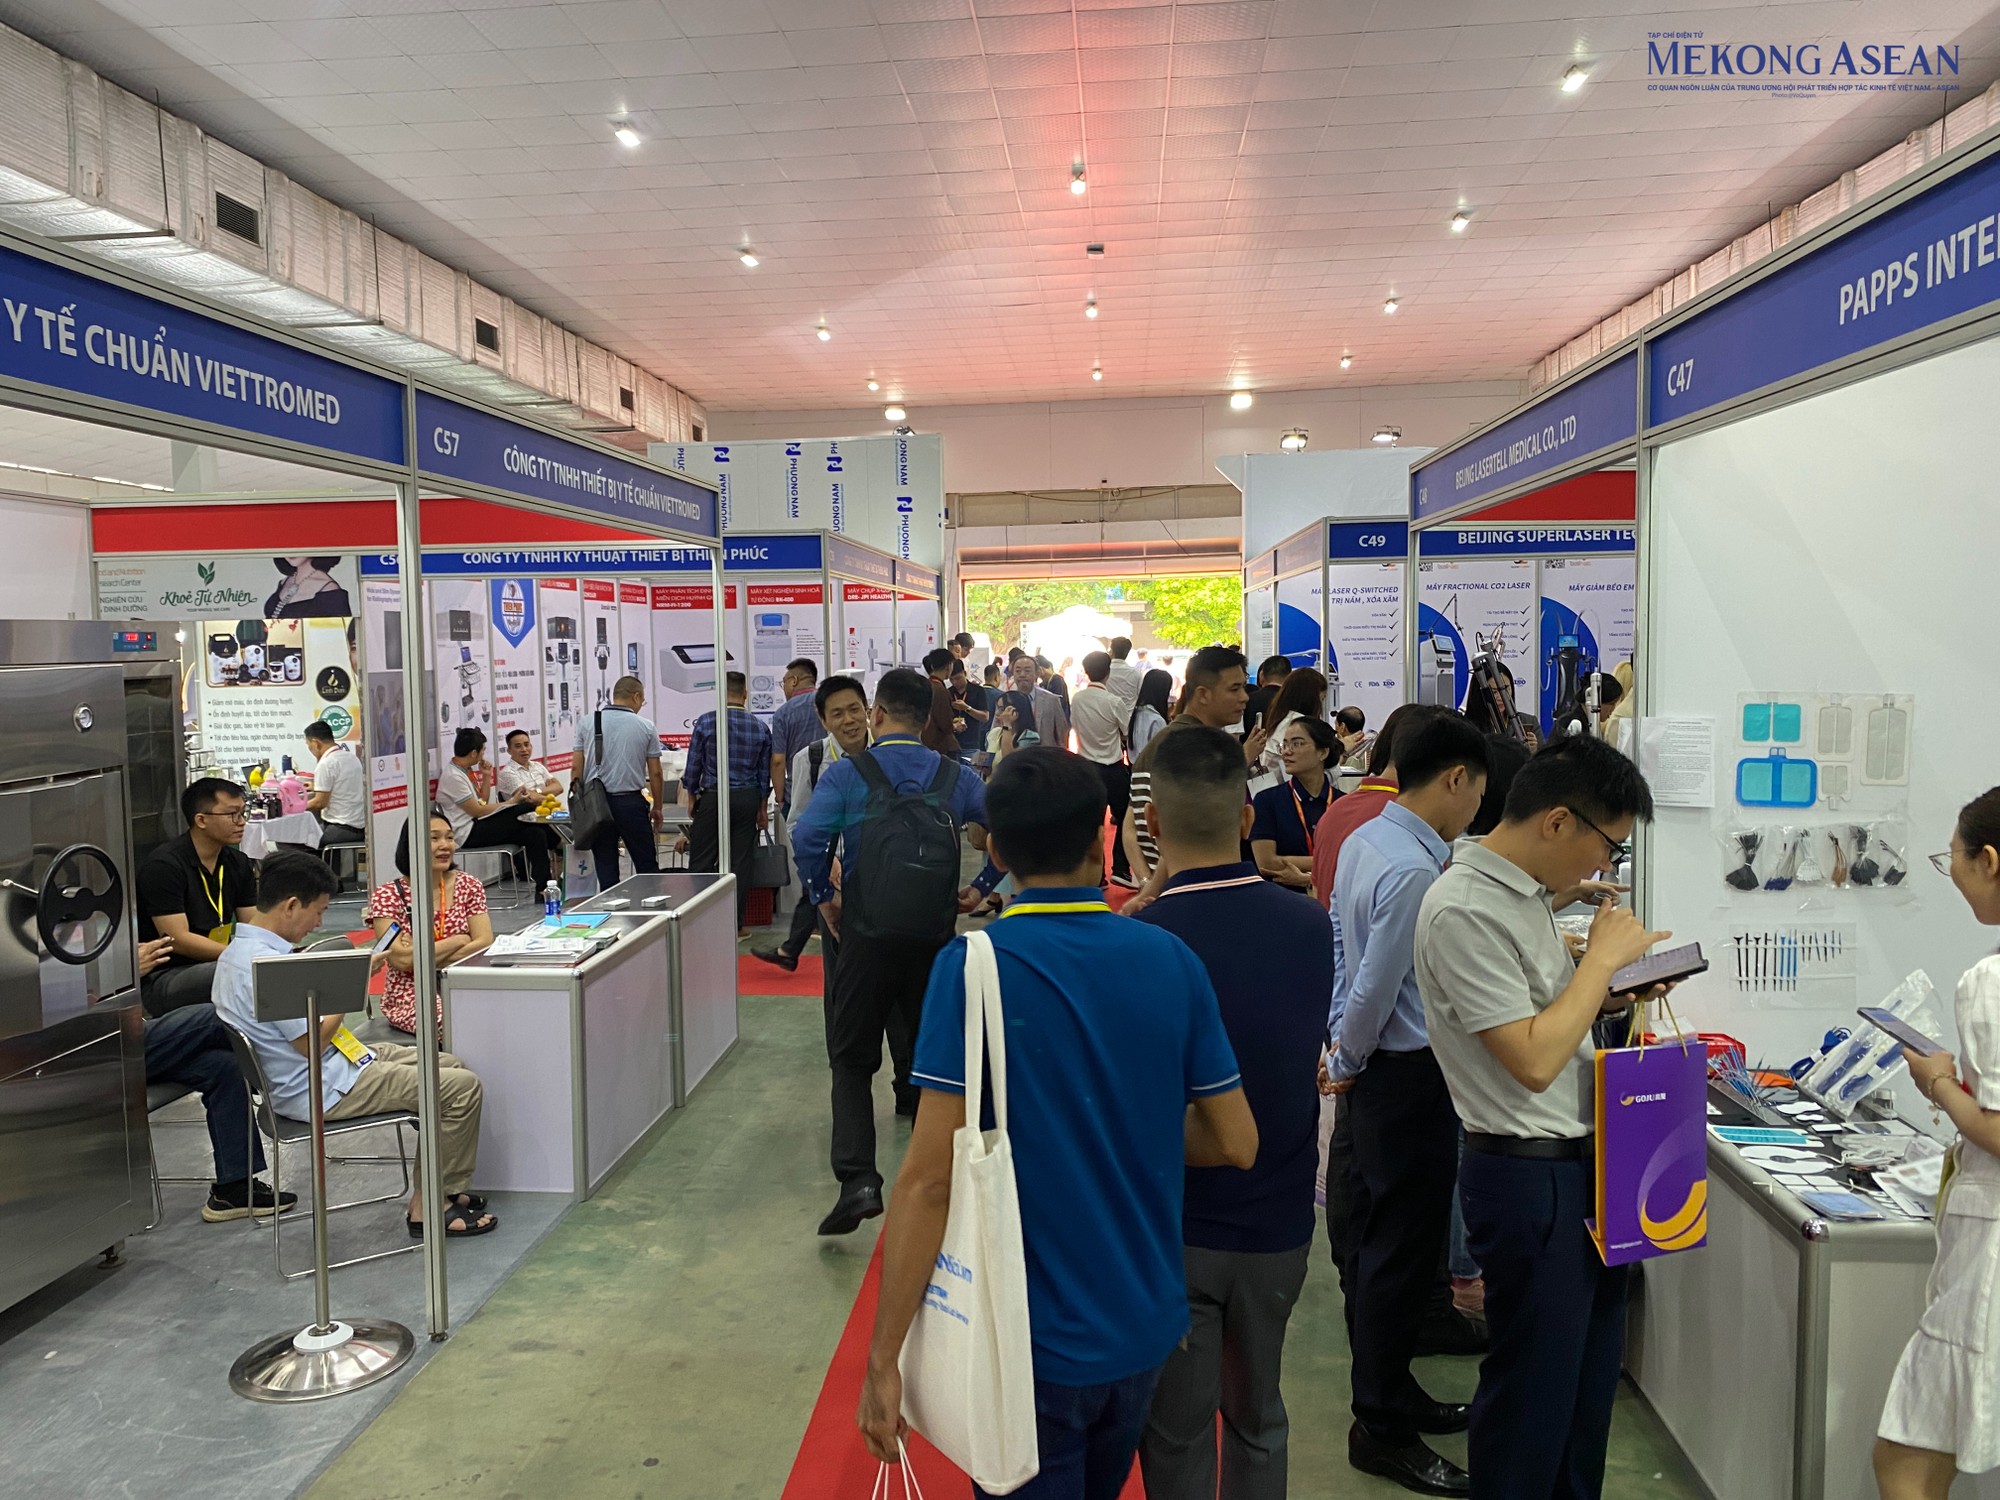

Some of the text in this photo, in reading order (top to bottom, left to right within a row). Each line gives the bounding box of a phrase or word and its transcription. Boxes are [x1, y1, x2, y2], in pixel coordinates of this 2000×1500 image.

[1839, 211, 2000, 326] PAPPS INTE
[2, 298, 340, 425] Y TẾ CHUẨN VIETTROMED
[1667, 358, 1694, 397] C47
[434, 427, 459, 457] C57
[1455, 463, 1474, 490] BEIJING
[1475, 448, 1508, 481] LASERTELL
[1508, 432, 1542, 467] MEDICAL
[1560, 415, 1577, 444] LTD
[503, 444, 537, 478] CÔNG
[537, 457, 551, 482] TY
[552, 462, 581, 490] TNHH
[581, 467, 607, 497] THIẾT
[608, 479, 617, 504] BỊ
[617, 481, 623, 501] Y
[624, 478, 634, 504] TẾ
[634, 484, 660, 511] CHUẨN
[660, 494, 700, 520] VIETTROMED
[719, 473, 727, 494] NAM
[900, 464, 908, 486] NAM
[790, 458, 799, 518] PHUONG NAM
[832, 483, 840, 532] UONG NAM
[901, 514, 910, 552] PHUONG
[1358, 535, 1386, 547] C49
[1458, 531, 1514, 544] BEIJING
[1517, 530, 1610, 543] SUPERLASER
[380, 554, 399, 565] C5
[502, 551, 520, 563] TY
[524, 551, 561, 563] TNHH
[672, 549, 684, 564] BỊ
[686, 549, 727, 561] THIN
[731, 545, 768, 560] PHÚC
[1311, 586, 1398, 595] MÁ LASER Q-SWITCHED
[1426, 582, 1531, 591] MÁY FRACTIONAL CO2 LASER
[1568, 583, 1584, 591] MÁY
[1585, 583, 1605, 591] GIẢM
[1606, 583, 1622, 591] BÉO
[214, 588, 258, 607] Nhiên
[1345, 596, 1361, 604] NÁM
[1366, 595, 1381, 603] XÓA
[325, 717, 351, 727] ACCP
[1636, 1094, 1654, 1103] GOJU
